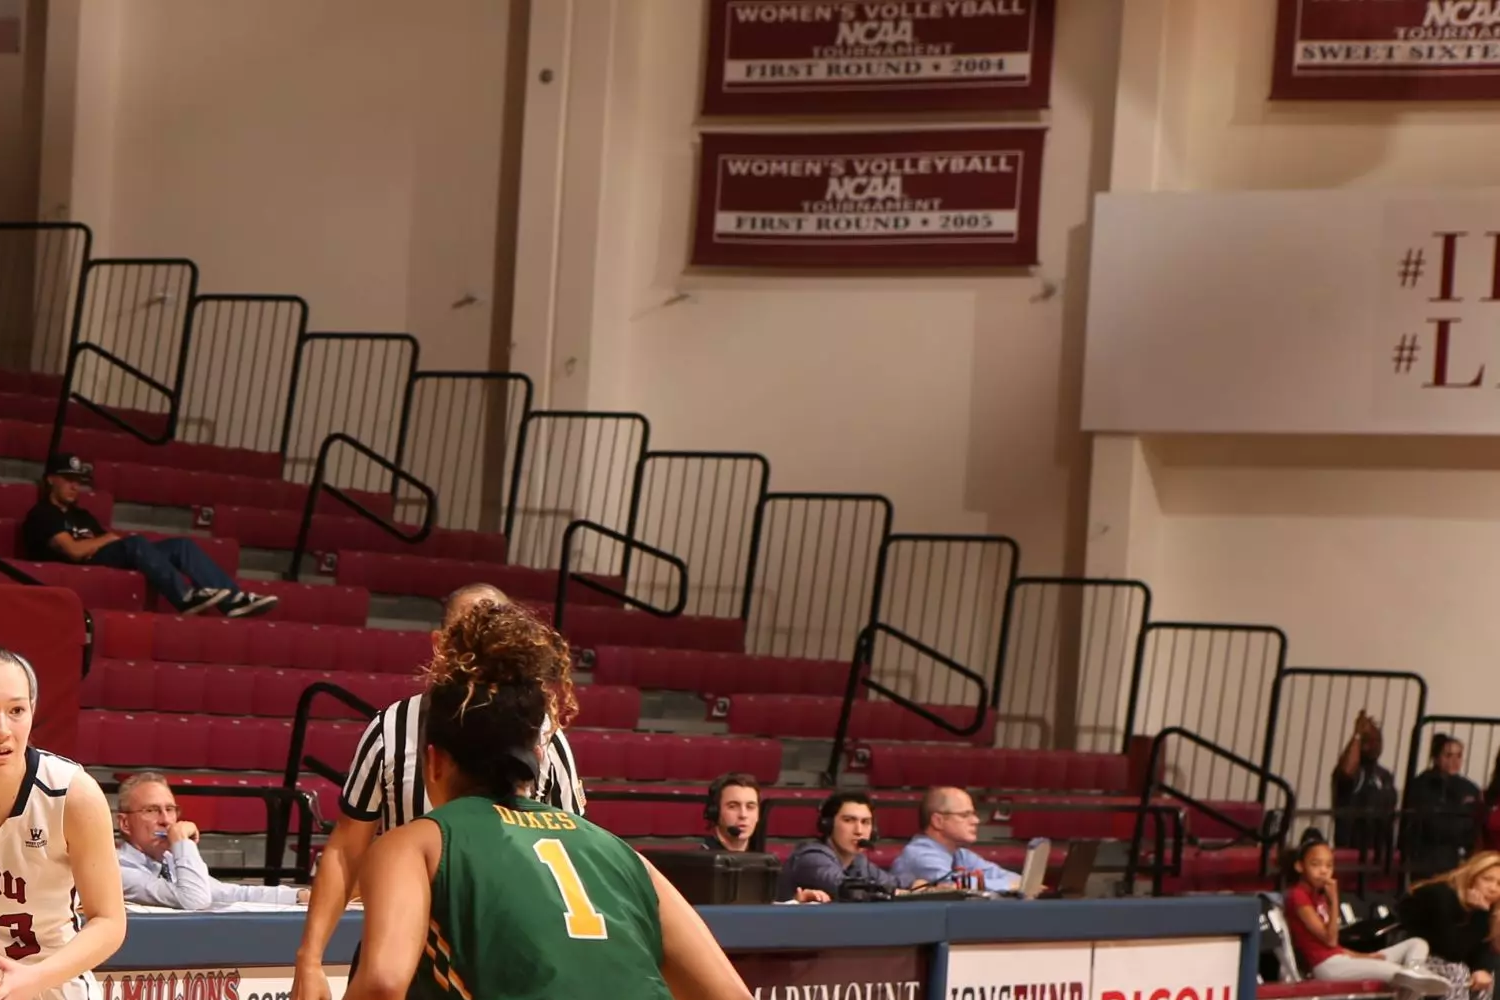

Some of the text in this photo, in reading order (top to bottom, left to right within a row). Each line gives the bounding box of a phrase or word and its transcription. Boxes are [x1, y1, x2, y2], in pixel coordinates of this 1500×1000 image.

[735, 0, 1026, 23] WOMEN'S VOLLEYBALL
[835, 21, 914, 45] NCAA
[811, 42, 954, 58] TOURNAMENT
[1302, 44, 1396, 60] SWEET
[744, 57, 1006, 79] FIRST ROUND 2004
[727, 155, 1013, 177] WOMEN'S VOLLEYBALL
[825, 175, 902, 201] NCAA
[801, 197, 942, 213] TOURNAMENT
[735, 214, 993, 231] FIRST ROUND 2005
[533, 838, 608, 939] 1
